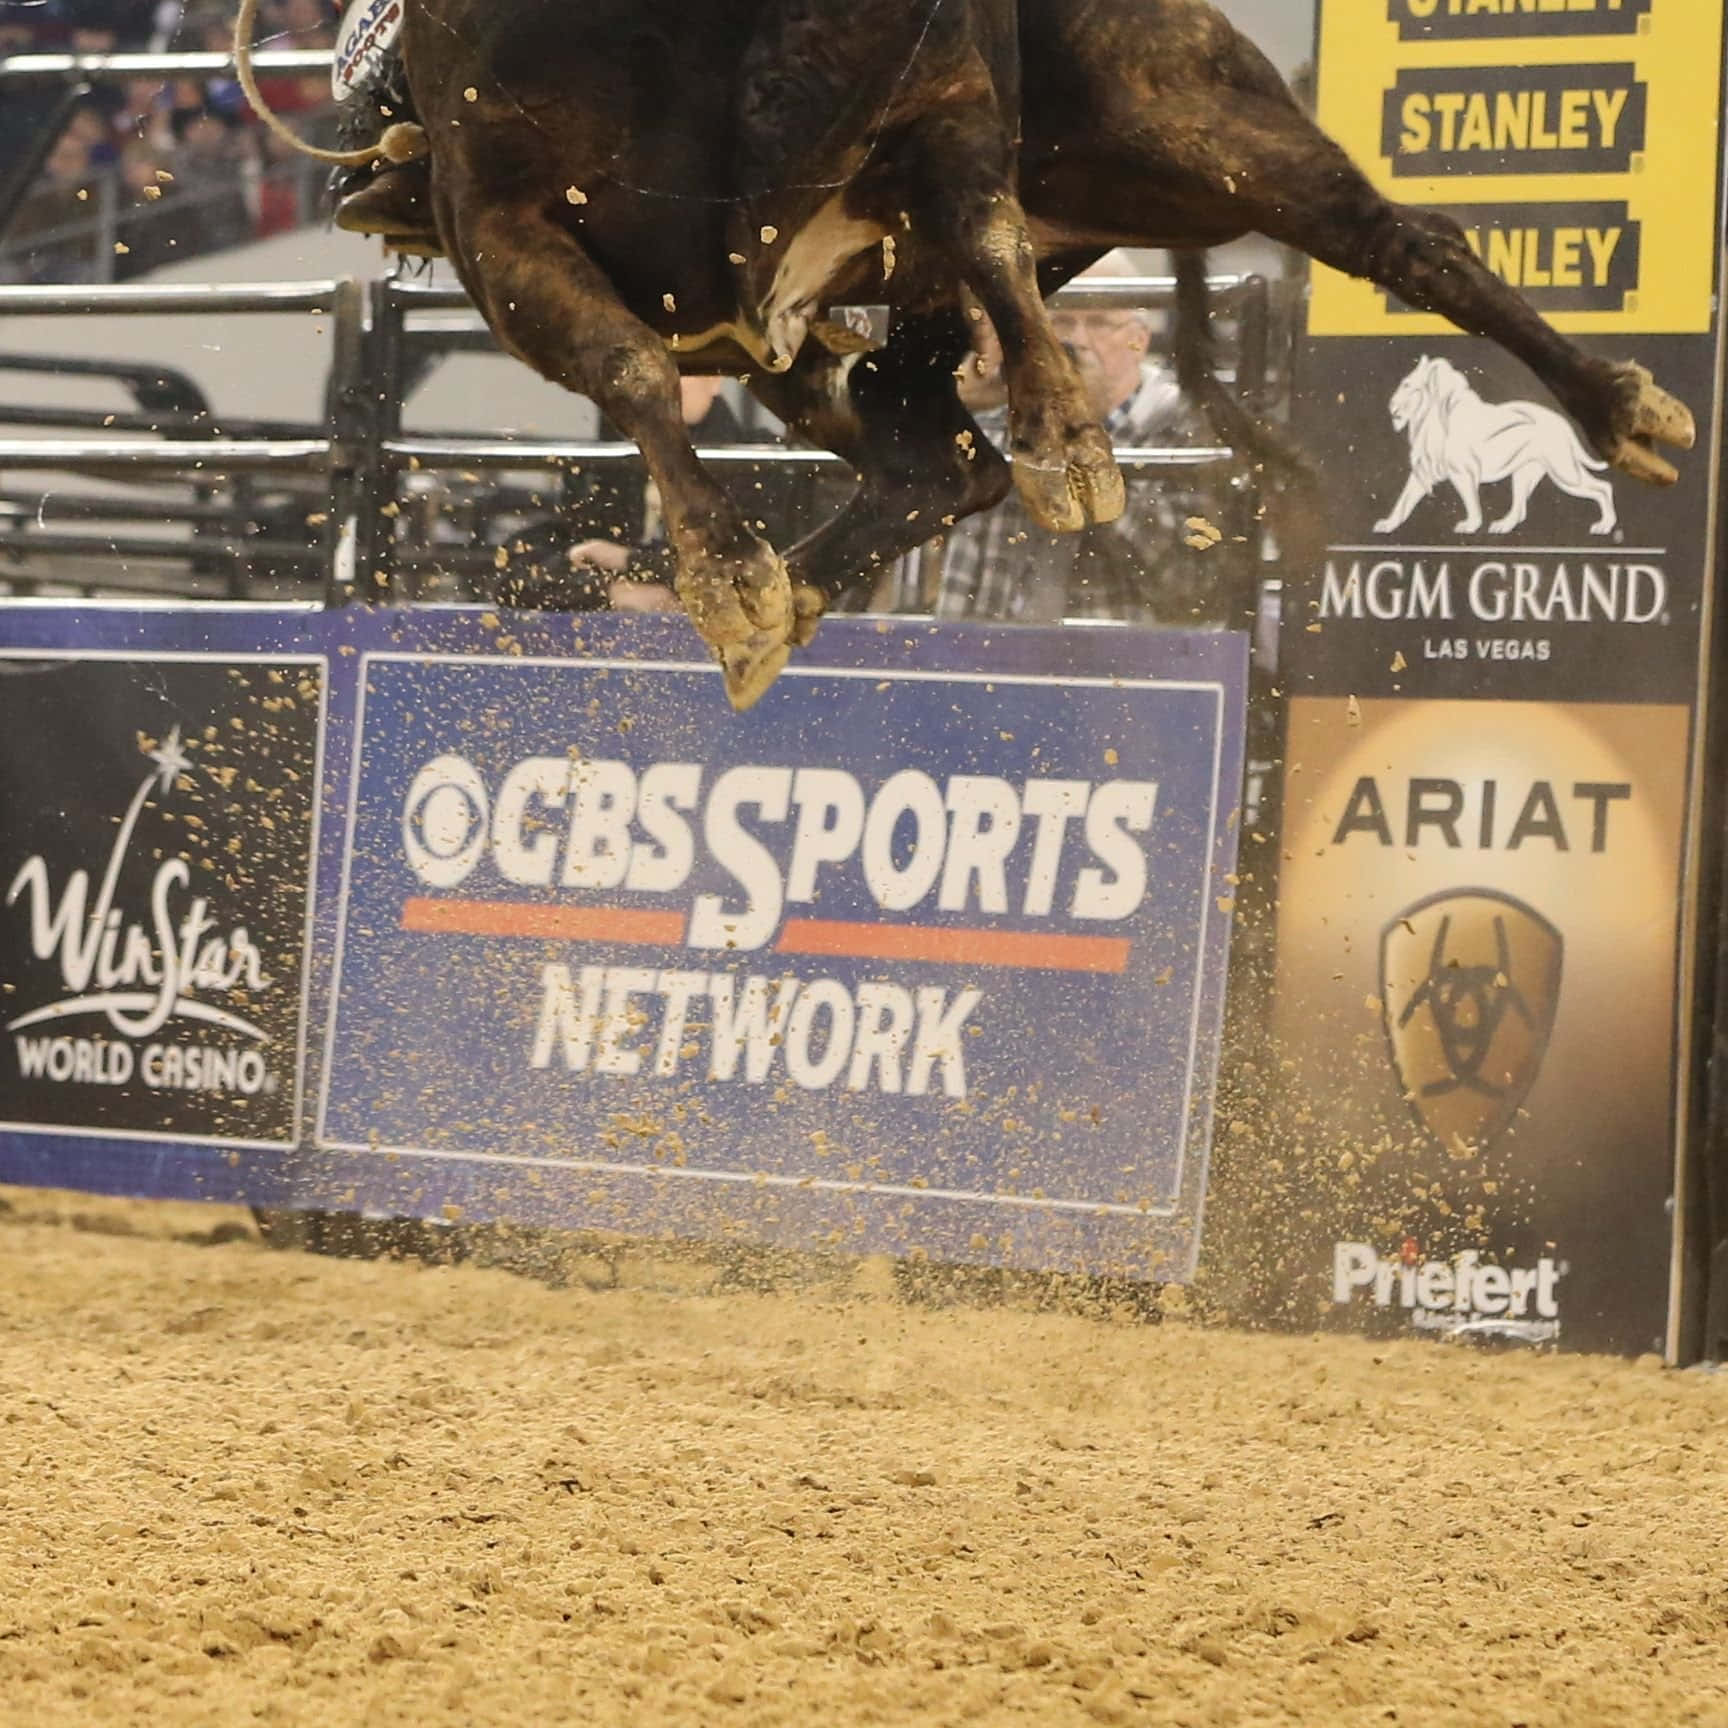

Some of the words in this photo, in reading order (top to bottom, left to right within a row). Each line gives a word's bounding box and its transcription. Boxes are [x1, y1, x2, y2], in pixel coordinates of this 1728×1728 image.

[1399, 88, 1629, 154] STANLEY
[1465, 227, 1622, 287] NLEY
[1319, 560, 1454, 619] MGM
[1468, 561, 1667, 623] GRAND
[1423, 638, 1468, 659] LAS
[1475, 639, 1552, 661] VEGAS
[1333, 775, 1632, 854] ARIAT
[5, 856, 271, 1039] WinStar
[532, 964, 983, 1100] NETWORK
[16, 1035, 132, 1085] WORLD
[141, 1042, 266, 1096] CASINO
[1334, 1238, 1560, 1317] Priefert
